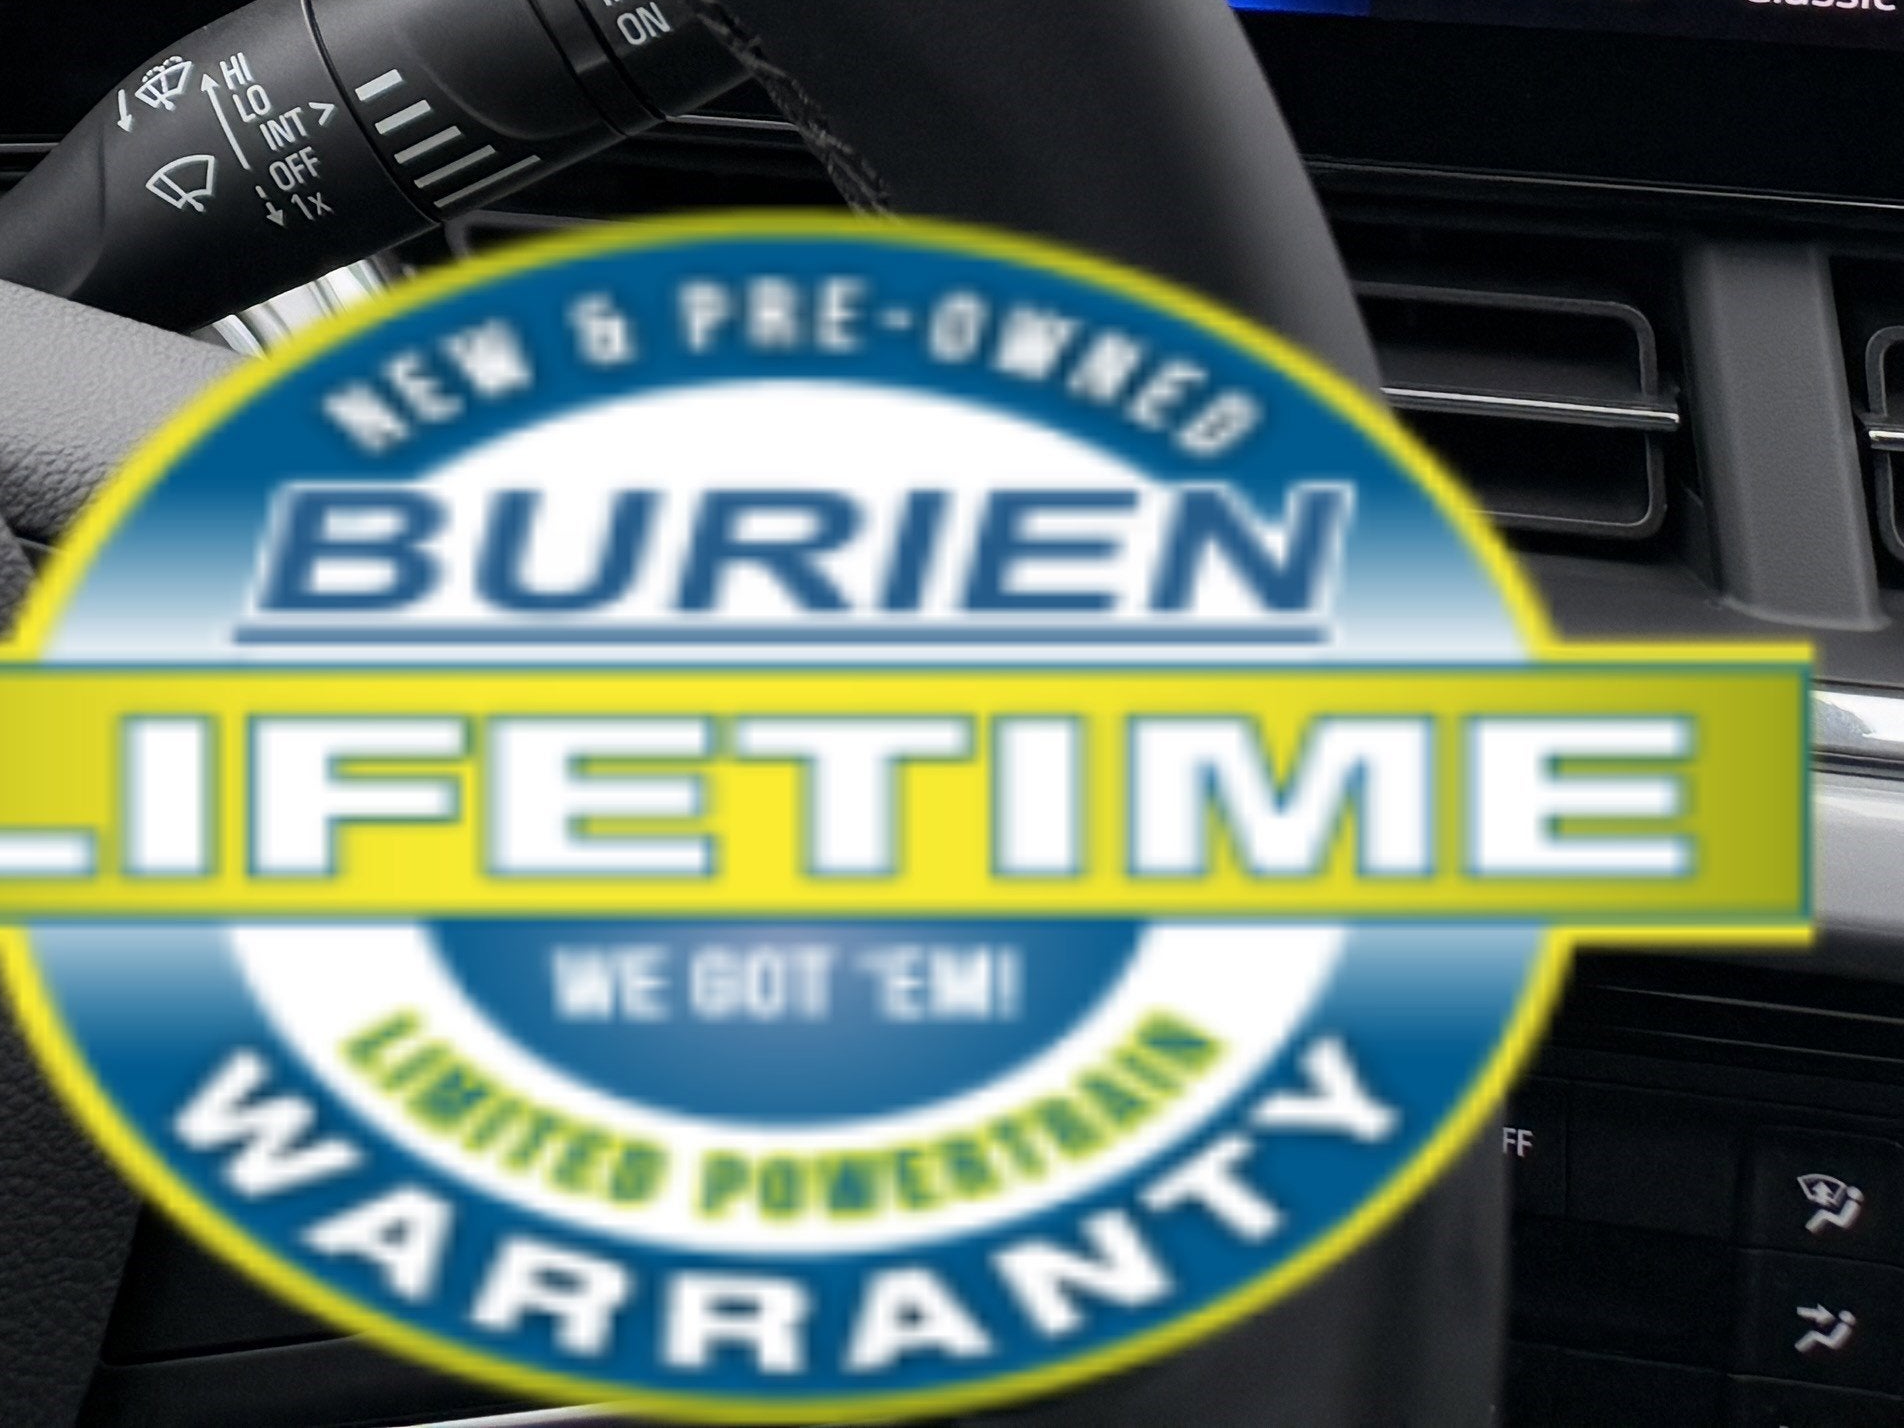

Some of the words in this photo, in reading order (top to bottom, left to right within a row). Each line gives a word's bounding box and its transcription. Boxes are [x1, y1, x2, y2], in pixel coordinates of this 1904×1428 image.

[617, 1, 671, 45] ON
[219, 52, 255, 90] HI
[232, 84, 272, 123] LO
[259, 106, 309, 152] INT
[269, 146, 321, 192] OFF
[1501, 1126, 1535, 1158] FF
